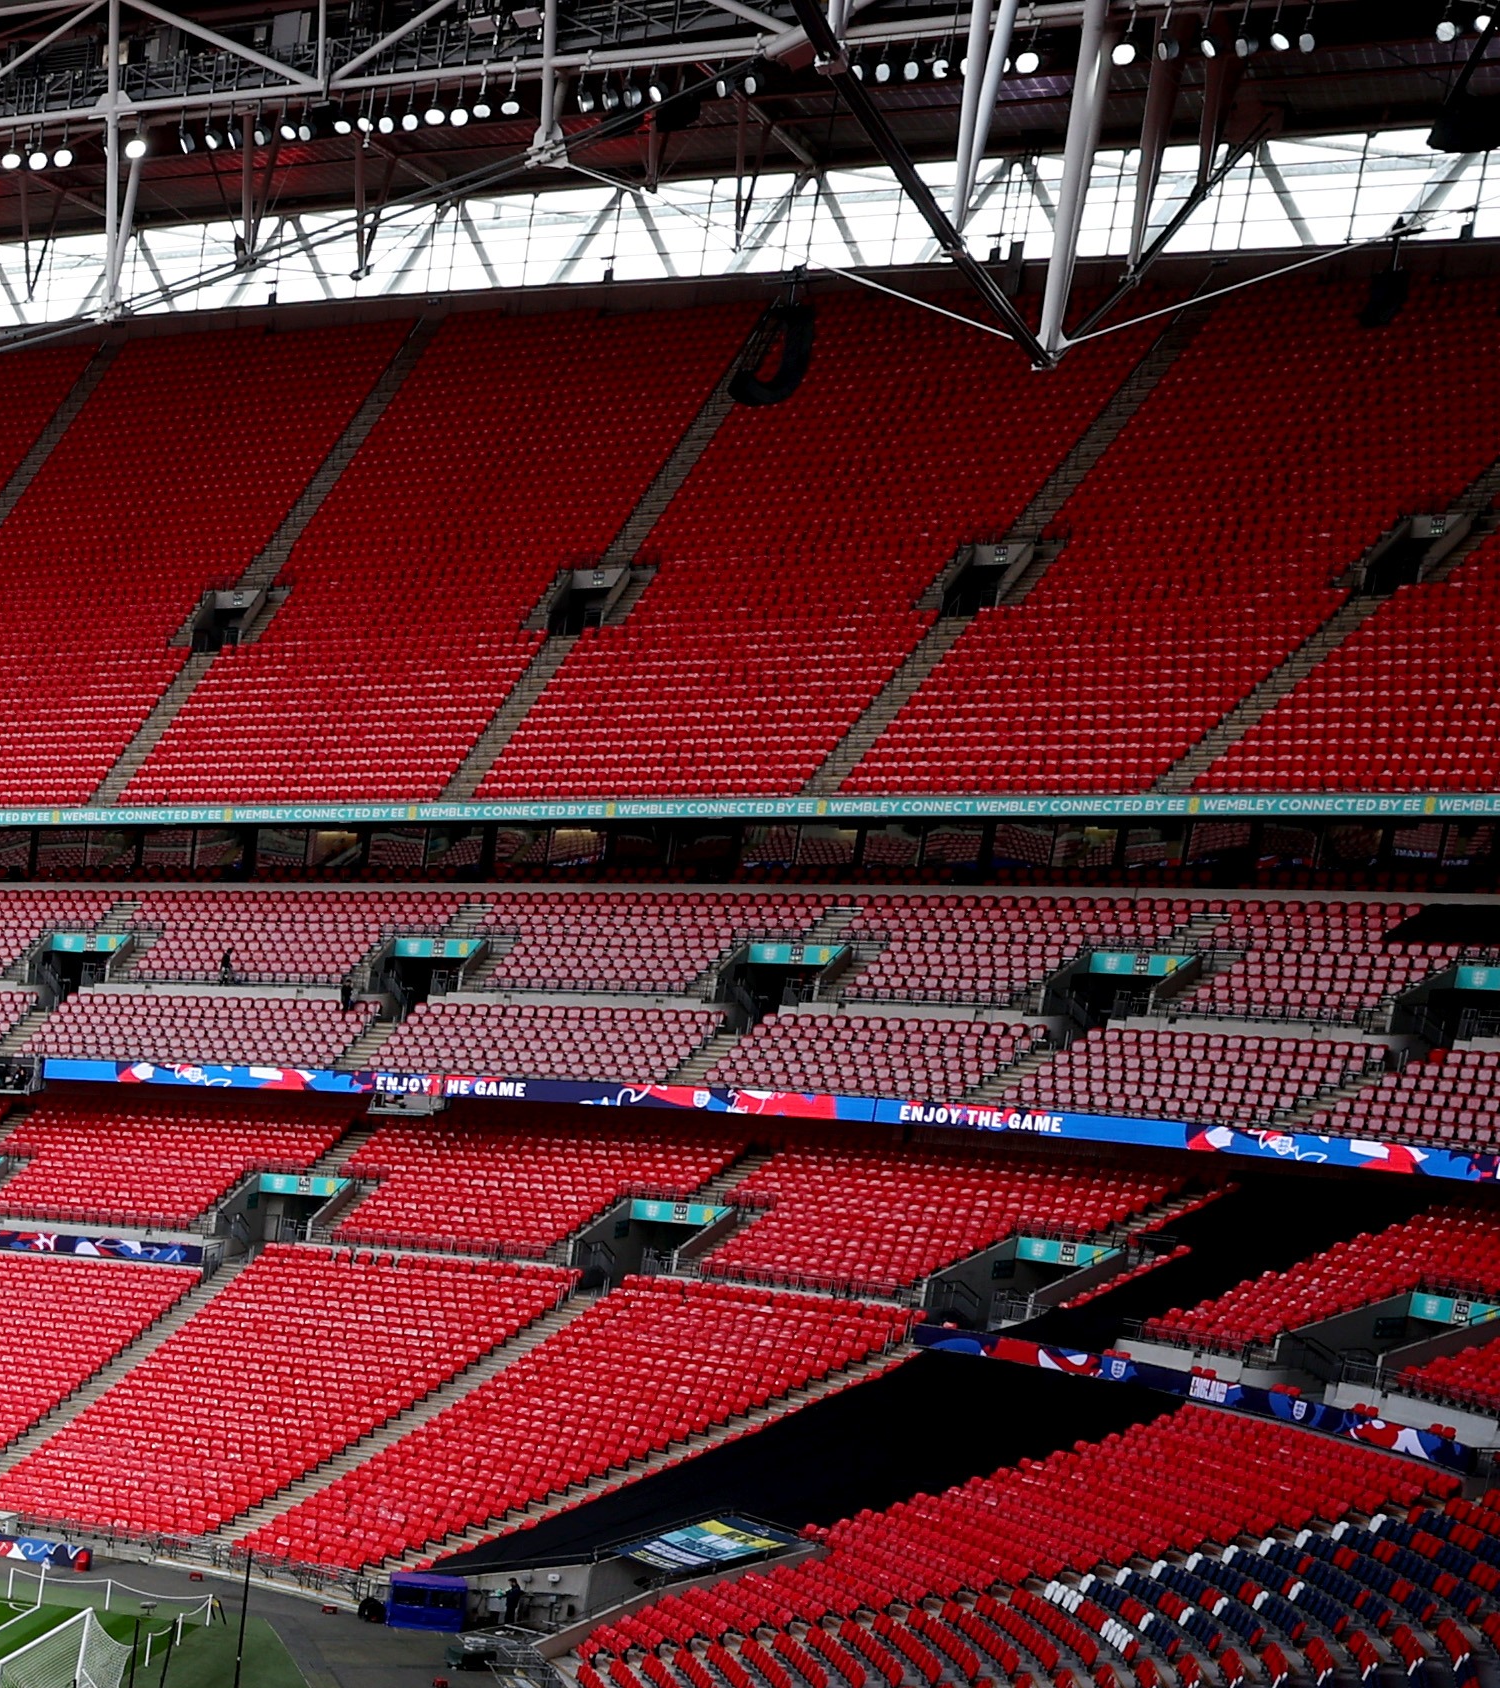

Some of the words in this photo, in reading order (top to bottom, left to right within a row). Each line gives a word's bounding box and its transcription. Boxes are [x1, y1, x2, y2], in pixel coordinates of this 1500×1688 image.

[420, 807, 481, 819] WEMBLEY
[483, 805, 566, 818] CONNECTED
[568, 805, 585, 816] BY
[589, 805, 602, 816] EE
[830, 801, 897, 814] WEMBLEY
[901, 800, 971, 813] CONNECT
[976, 800, 1047, 813] WEMBLEY
[1049, 799, 1142, 813] CONNECTED
[1145, 799, 1163, 812] BY
[1168, 799, 1185, 812] EE
[21, 813, 35, 823] BY
[38, 812, 49, 823] EE
[377, 1077, 431, 1092] ENJOY
[475, 1081, 526, 1096] GAME
[900, 1105, 961, 1124] ENJOY
[967, 1110, 1003, 1127] THE
[1008, 1114, 1062, 1132] GAME
